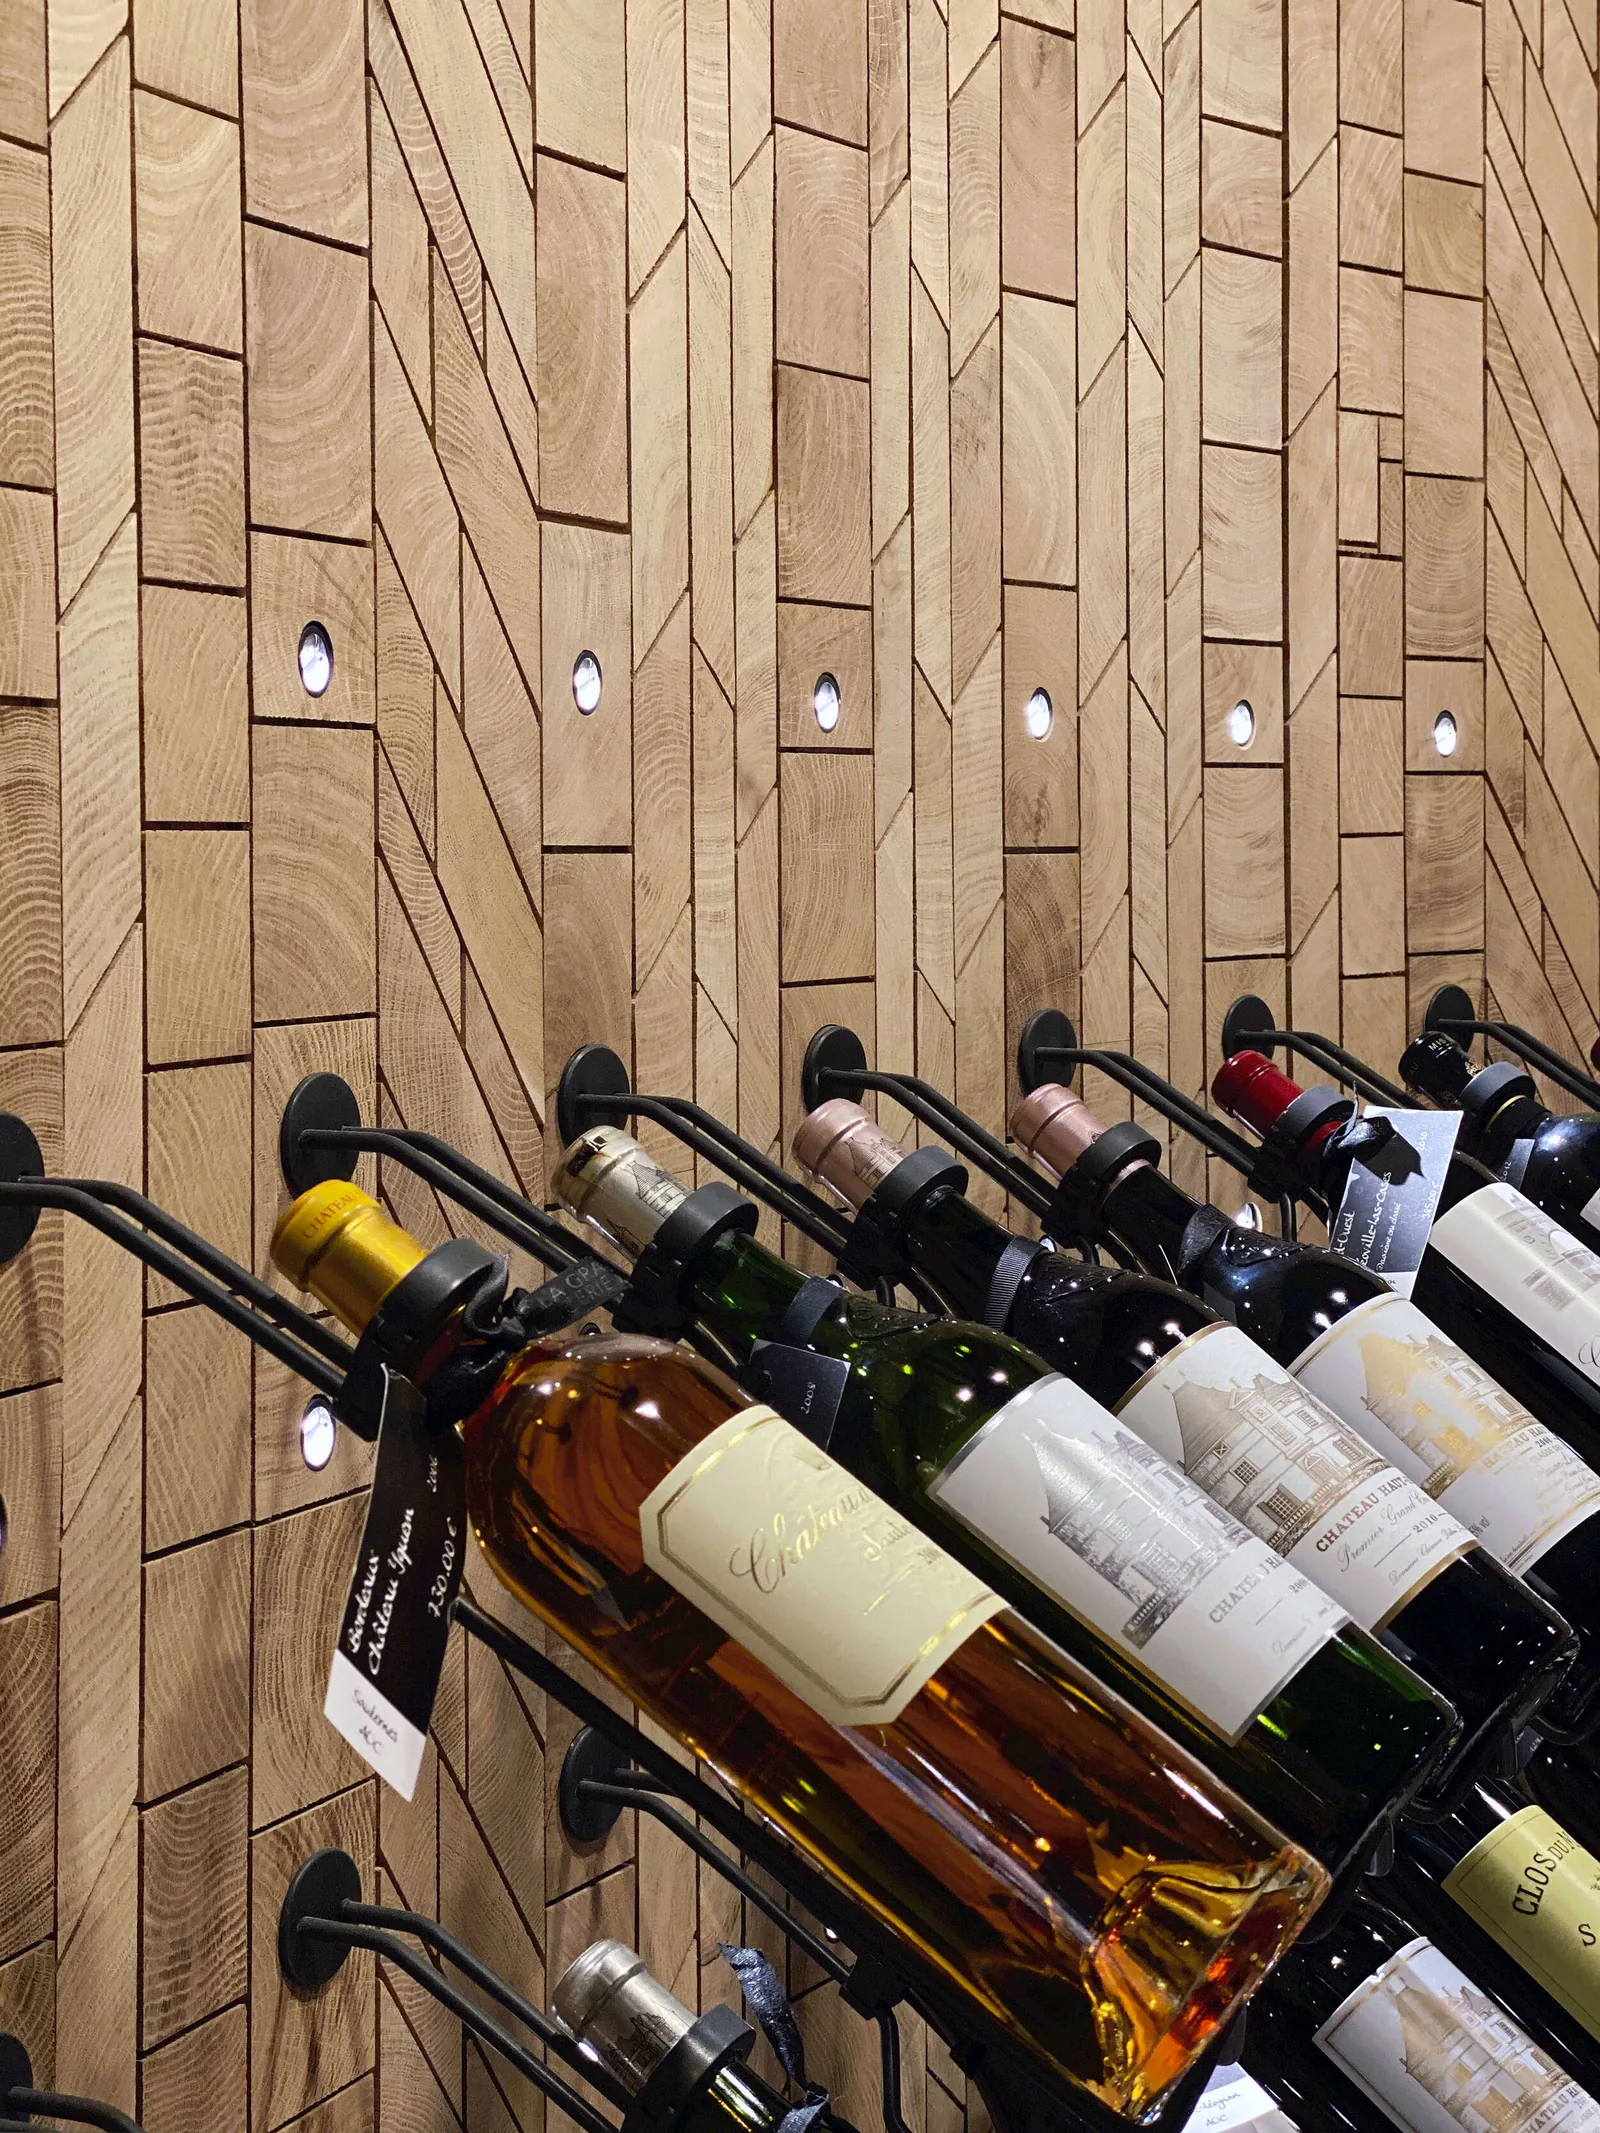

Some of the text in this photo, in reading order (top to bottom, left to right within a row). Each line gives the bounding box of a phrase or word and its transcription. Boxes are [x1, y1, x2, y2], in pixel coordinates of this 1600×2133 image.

[800, 1381, 816, 1415] 2008
[1316, 1493, 1380, 1553] CHATEAU
[1337, 1526, 1386, 1573] Premier
[1380, 1493, 1417, 1527] Grand
[1412, 1513, 1439, 1535] 2010
[1479, 1514, 1492, 1530] vol
[1511, 1851, 1557, 1917] CLOS
[1546, 1840, 1571, 1862] DU
[1578, 1923, 1597, 1948] S
[1205, 2114, 1229, 2127] AOC
